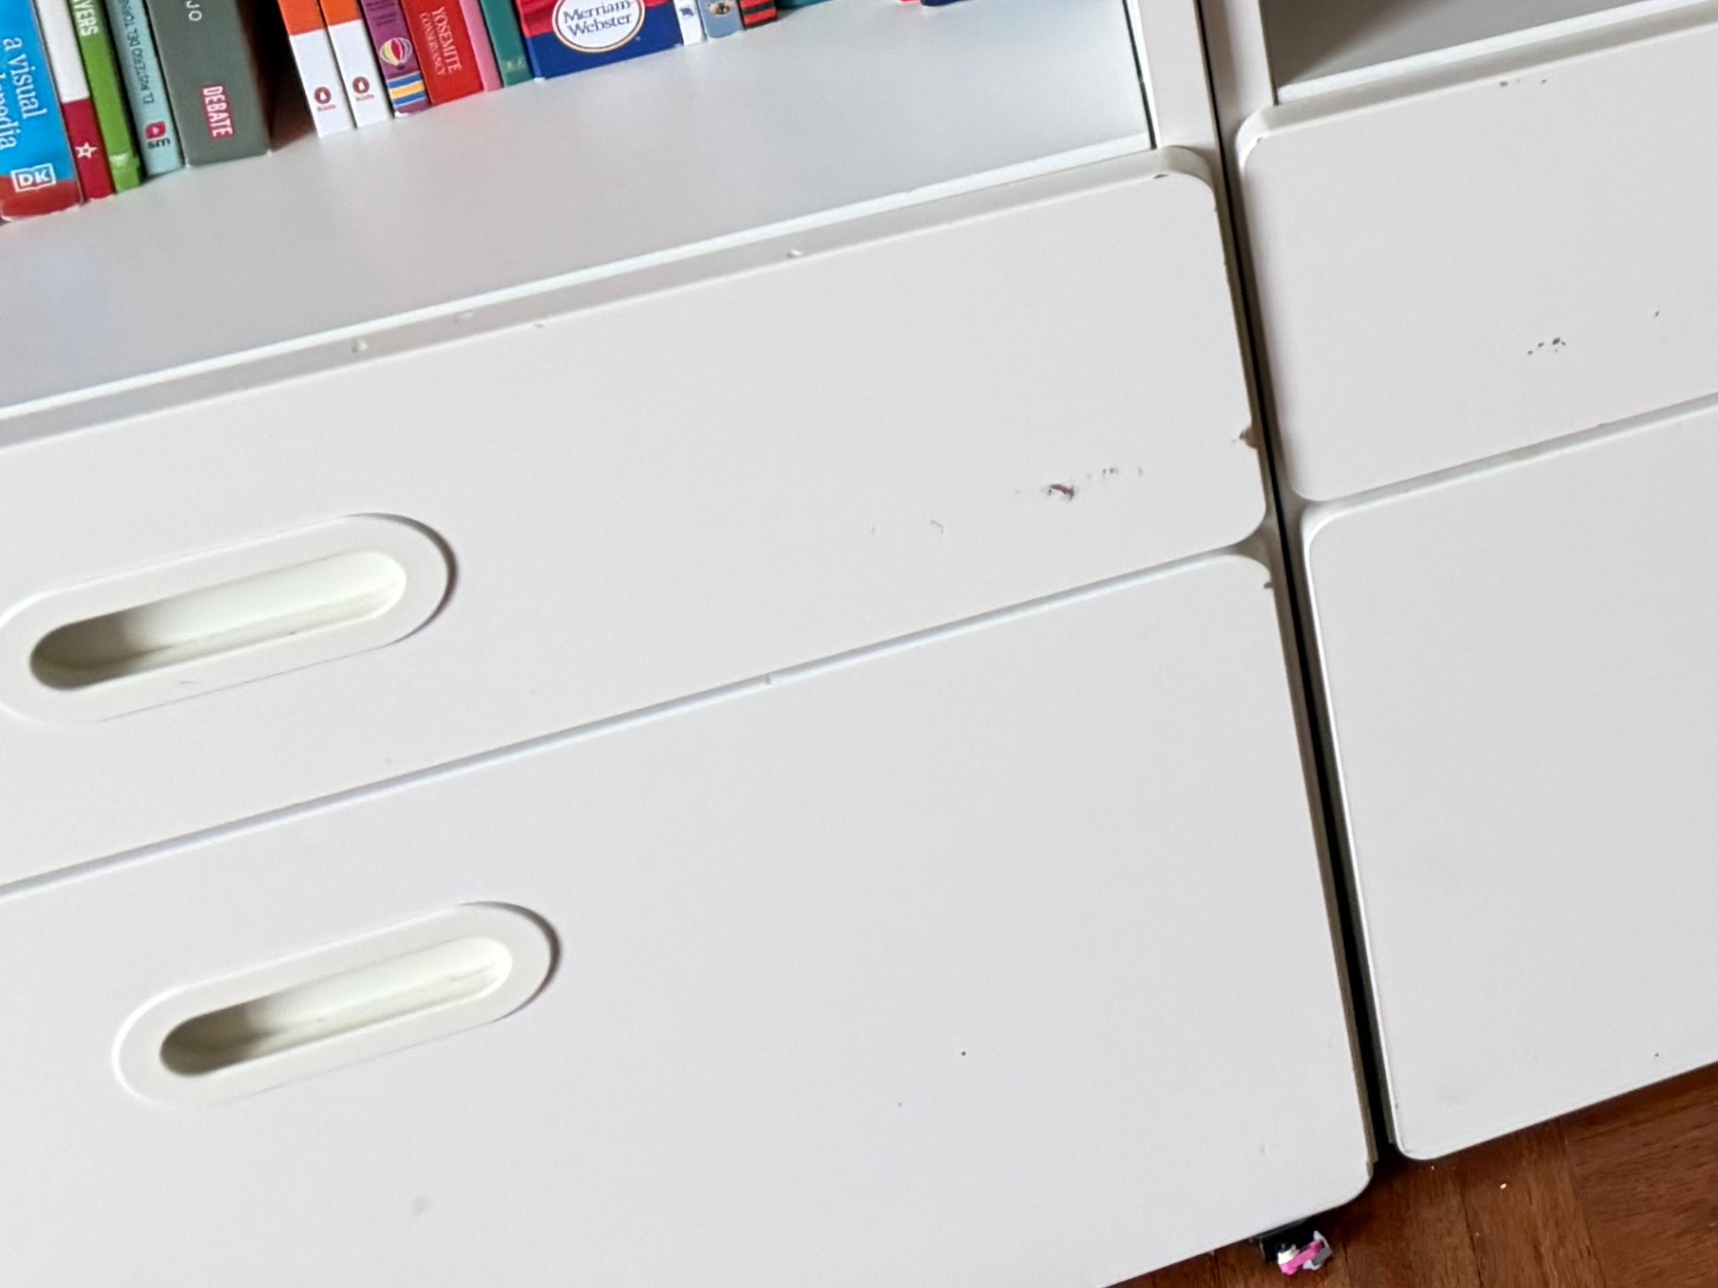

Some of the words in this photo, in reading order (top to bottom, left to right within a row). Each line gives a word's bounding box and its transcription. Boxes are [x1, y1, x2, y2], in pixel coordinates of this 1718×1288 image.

[563, 0, 635, 24] Merriam-
[567, 12, 633, 38] Webster
[432, 6, 463, 72] YOSEMITE
[8, 53, 48, 119] visual
[203, 85, 234, 137] DEBATE
